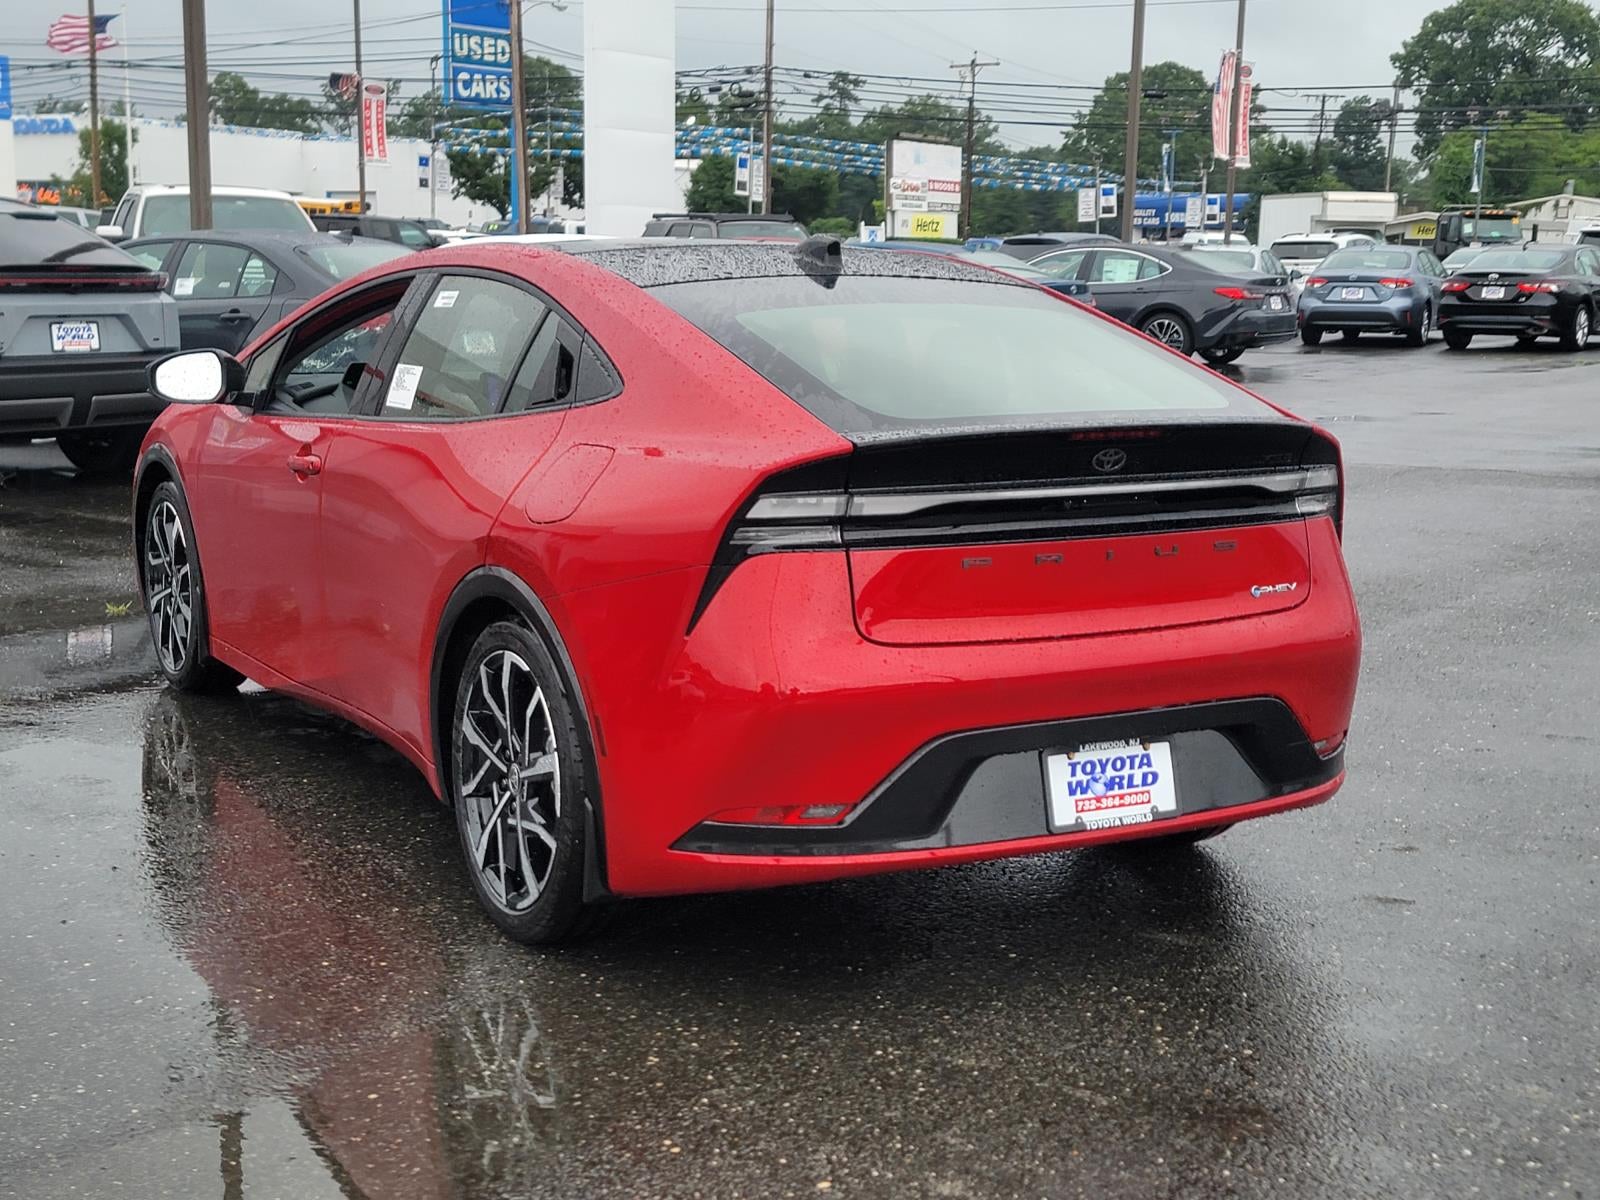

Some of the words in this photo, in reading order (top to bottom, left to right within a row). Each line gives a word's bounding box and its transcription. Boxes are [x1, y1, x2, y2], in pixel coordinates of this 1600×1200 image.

[453, 32, 511, 64] USED
[456, 71, 511, 101] CARS
[13, 117, 76, 134] ONDA
[1133, 208, 1157, 216] UALITY
[915, 218, 941, 233] Hertz
[1416, 225, 1436, 236] Her
[56, 325, 93, 334] TOYOTA
[961, 541, 1238, 569] PRIUS
[1067, 753, 1153, 778] TOYOTA
[1076, 792, 1150, 812] 732-364-9000
[1085, 815, 1122, 831] TOYOTA
[1123, 812, 1154, 826] WORLD
